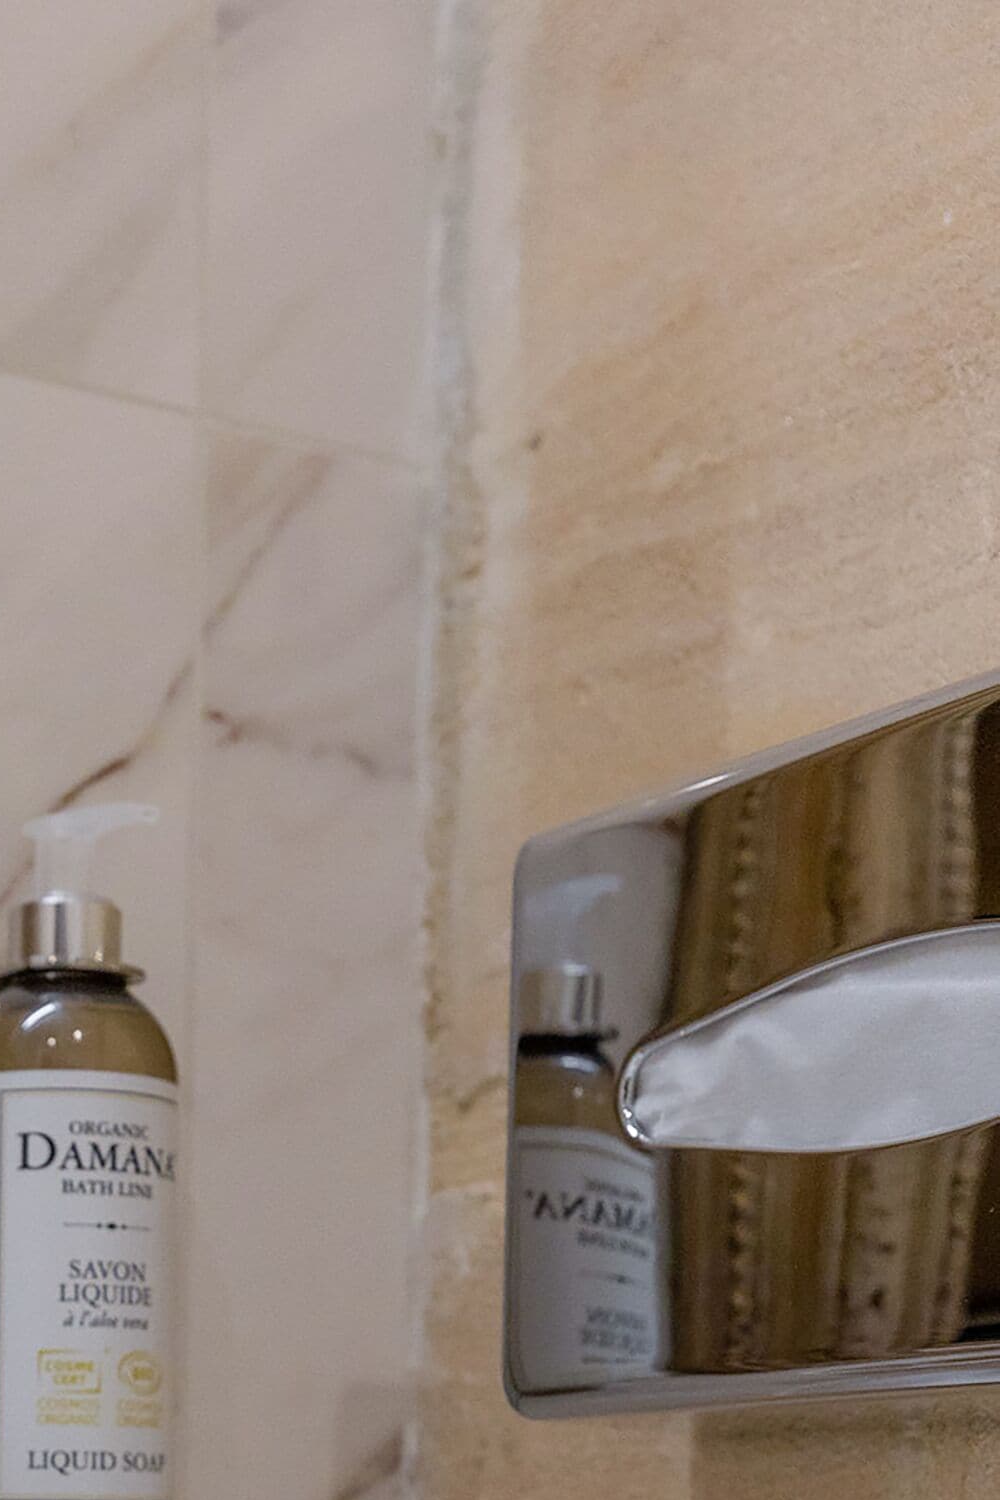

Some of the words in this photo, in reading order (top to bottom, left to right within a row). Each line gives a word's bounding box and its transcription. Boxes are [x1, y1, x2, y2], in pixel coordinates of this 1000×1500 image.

[68, 1120, 150, 1140] ORGANIC
[62, 1180, 114, 1197] BATH
[68, 1259, 148, 1282] SAVON
[59, 1283, 151, 1308] LIQUIDE
[28, 1449, 117, 1476] LIQUID
